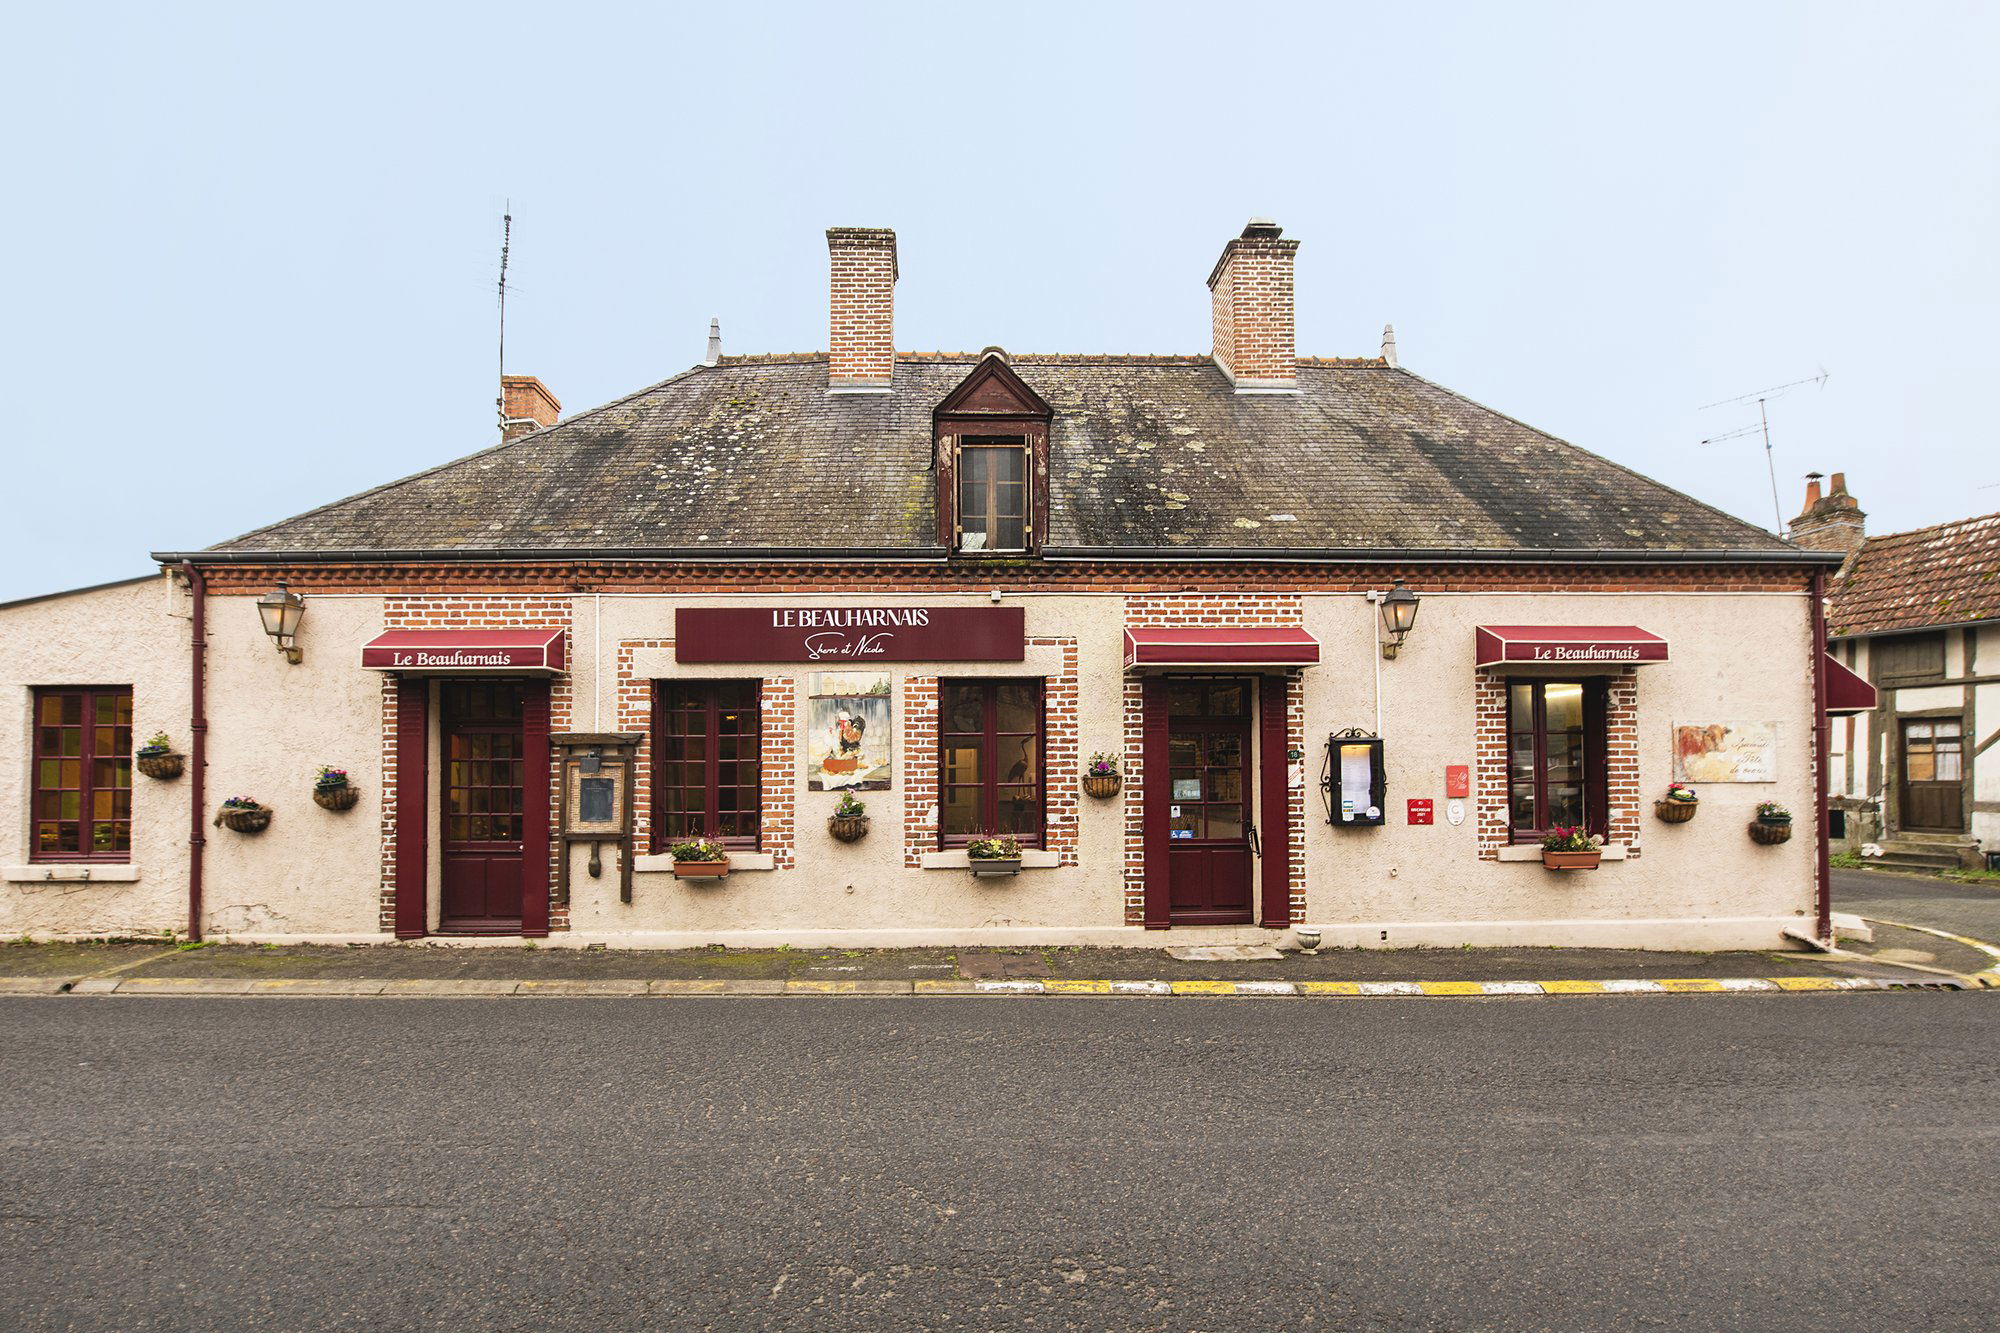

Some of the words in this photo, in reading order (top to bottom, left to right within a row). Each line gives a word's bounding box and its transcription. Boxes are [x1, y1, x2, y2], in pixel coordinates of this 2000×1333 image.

[773, 609, 796, 628] LE
[798, 608, 929, 627] BEAUHARNAIS
[841, 641, 852, 655] et
[851, 632, 894, 657] Nicola
[1533, 646, 1552, 660] Le
[1554, 644, 1640, 660] Beauharnais
[393, 652, 413, 666] Le
[416, 650, 511, 666] Beauharnais
